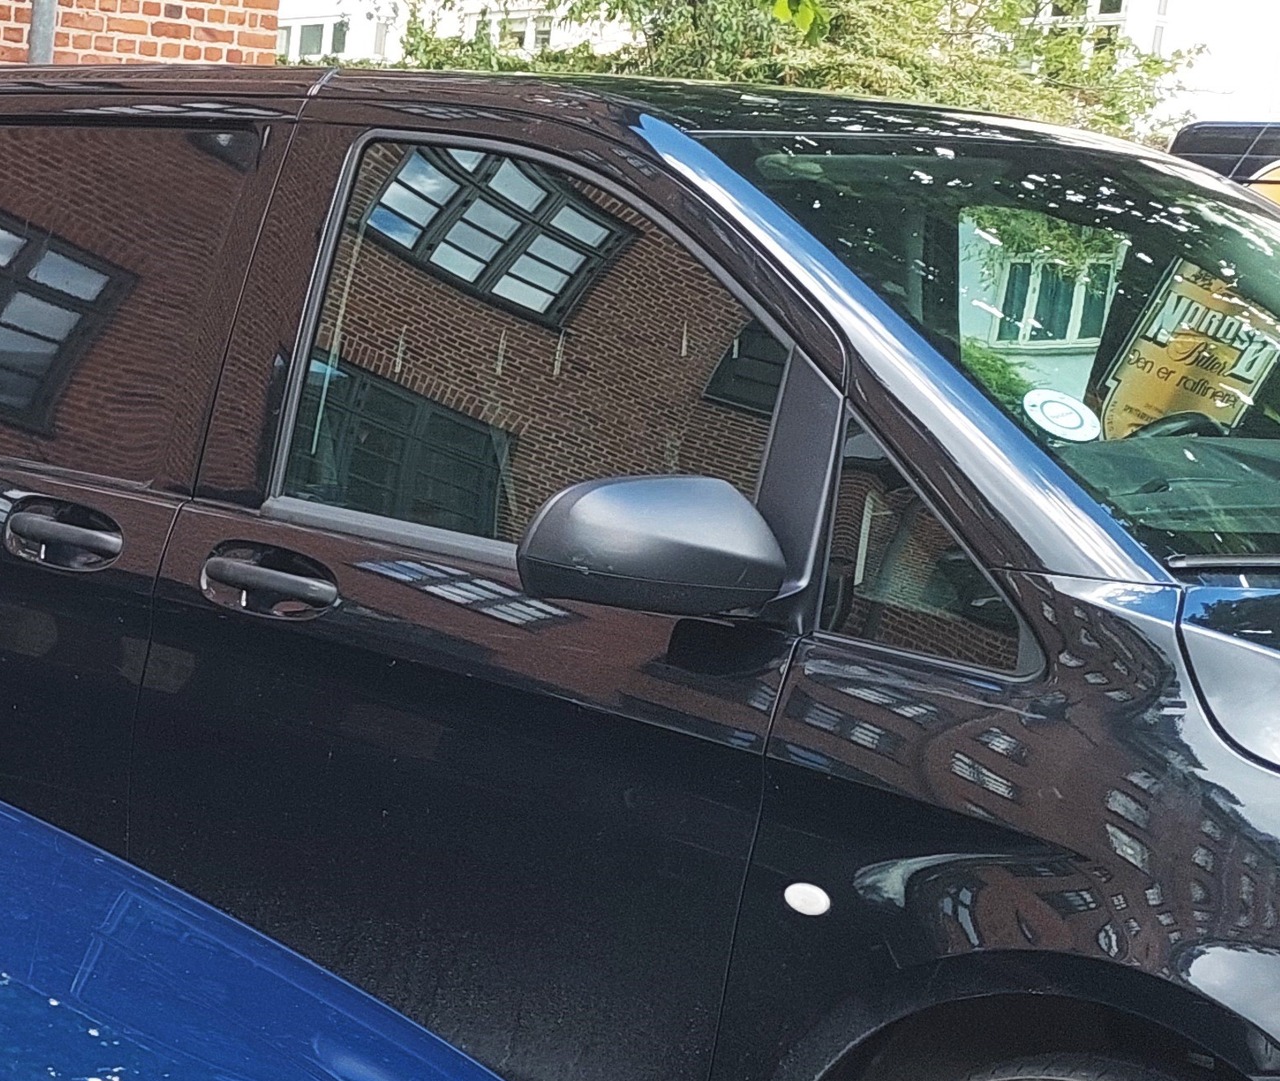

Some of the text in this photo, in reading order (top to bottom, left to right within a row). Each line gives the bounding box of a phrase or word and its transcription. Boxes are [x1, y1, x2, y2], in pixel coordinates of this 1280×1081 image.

[1128, 348, 1154, 374] Den
[1156, 366, 1176, 382] er
[1167, 342, 1228, 377] Bitter
